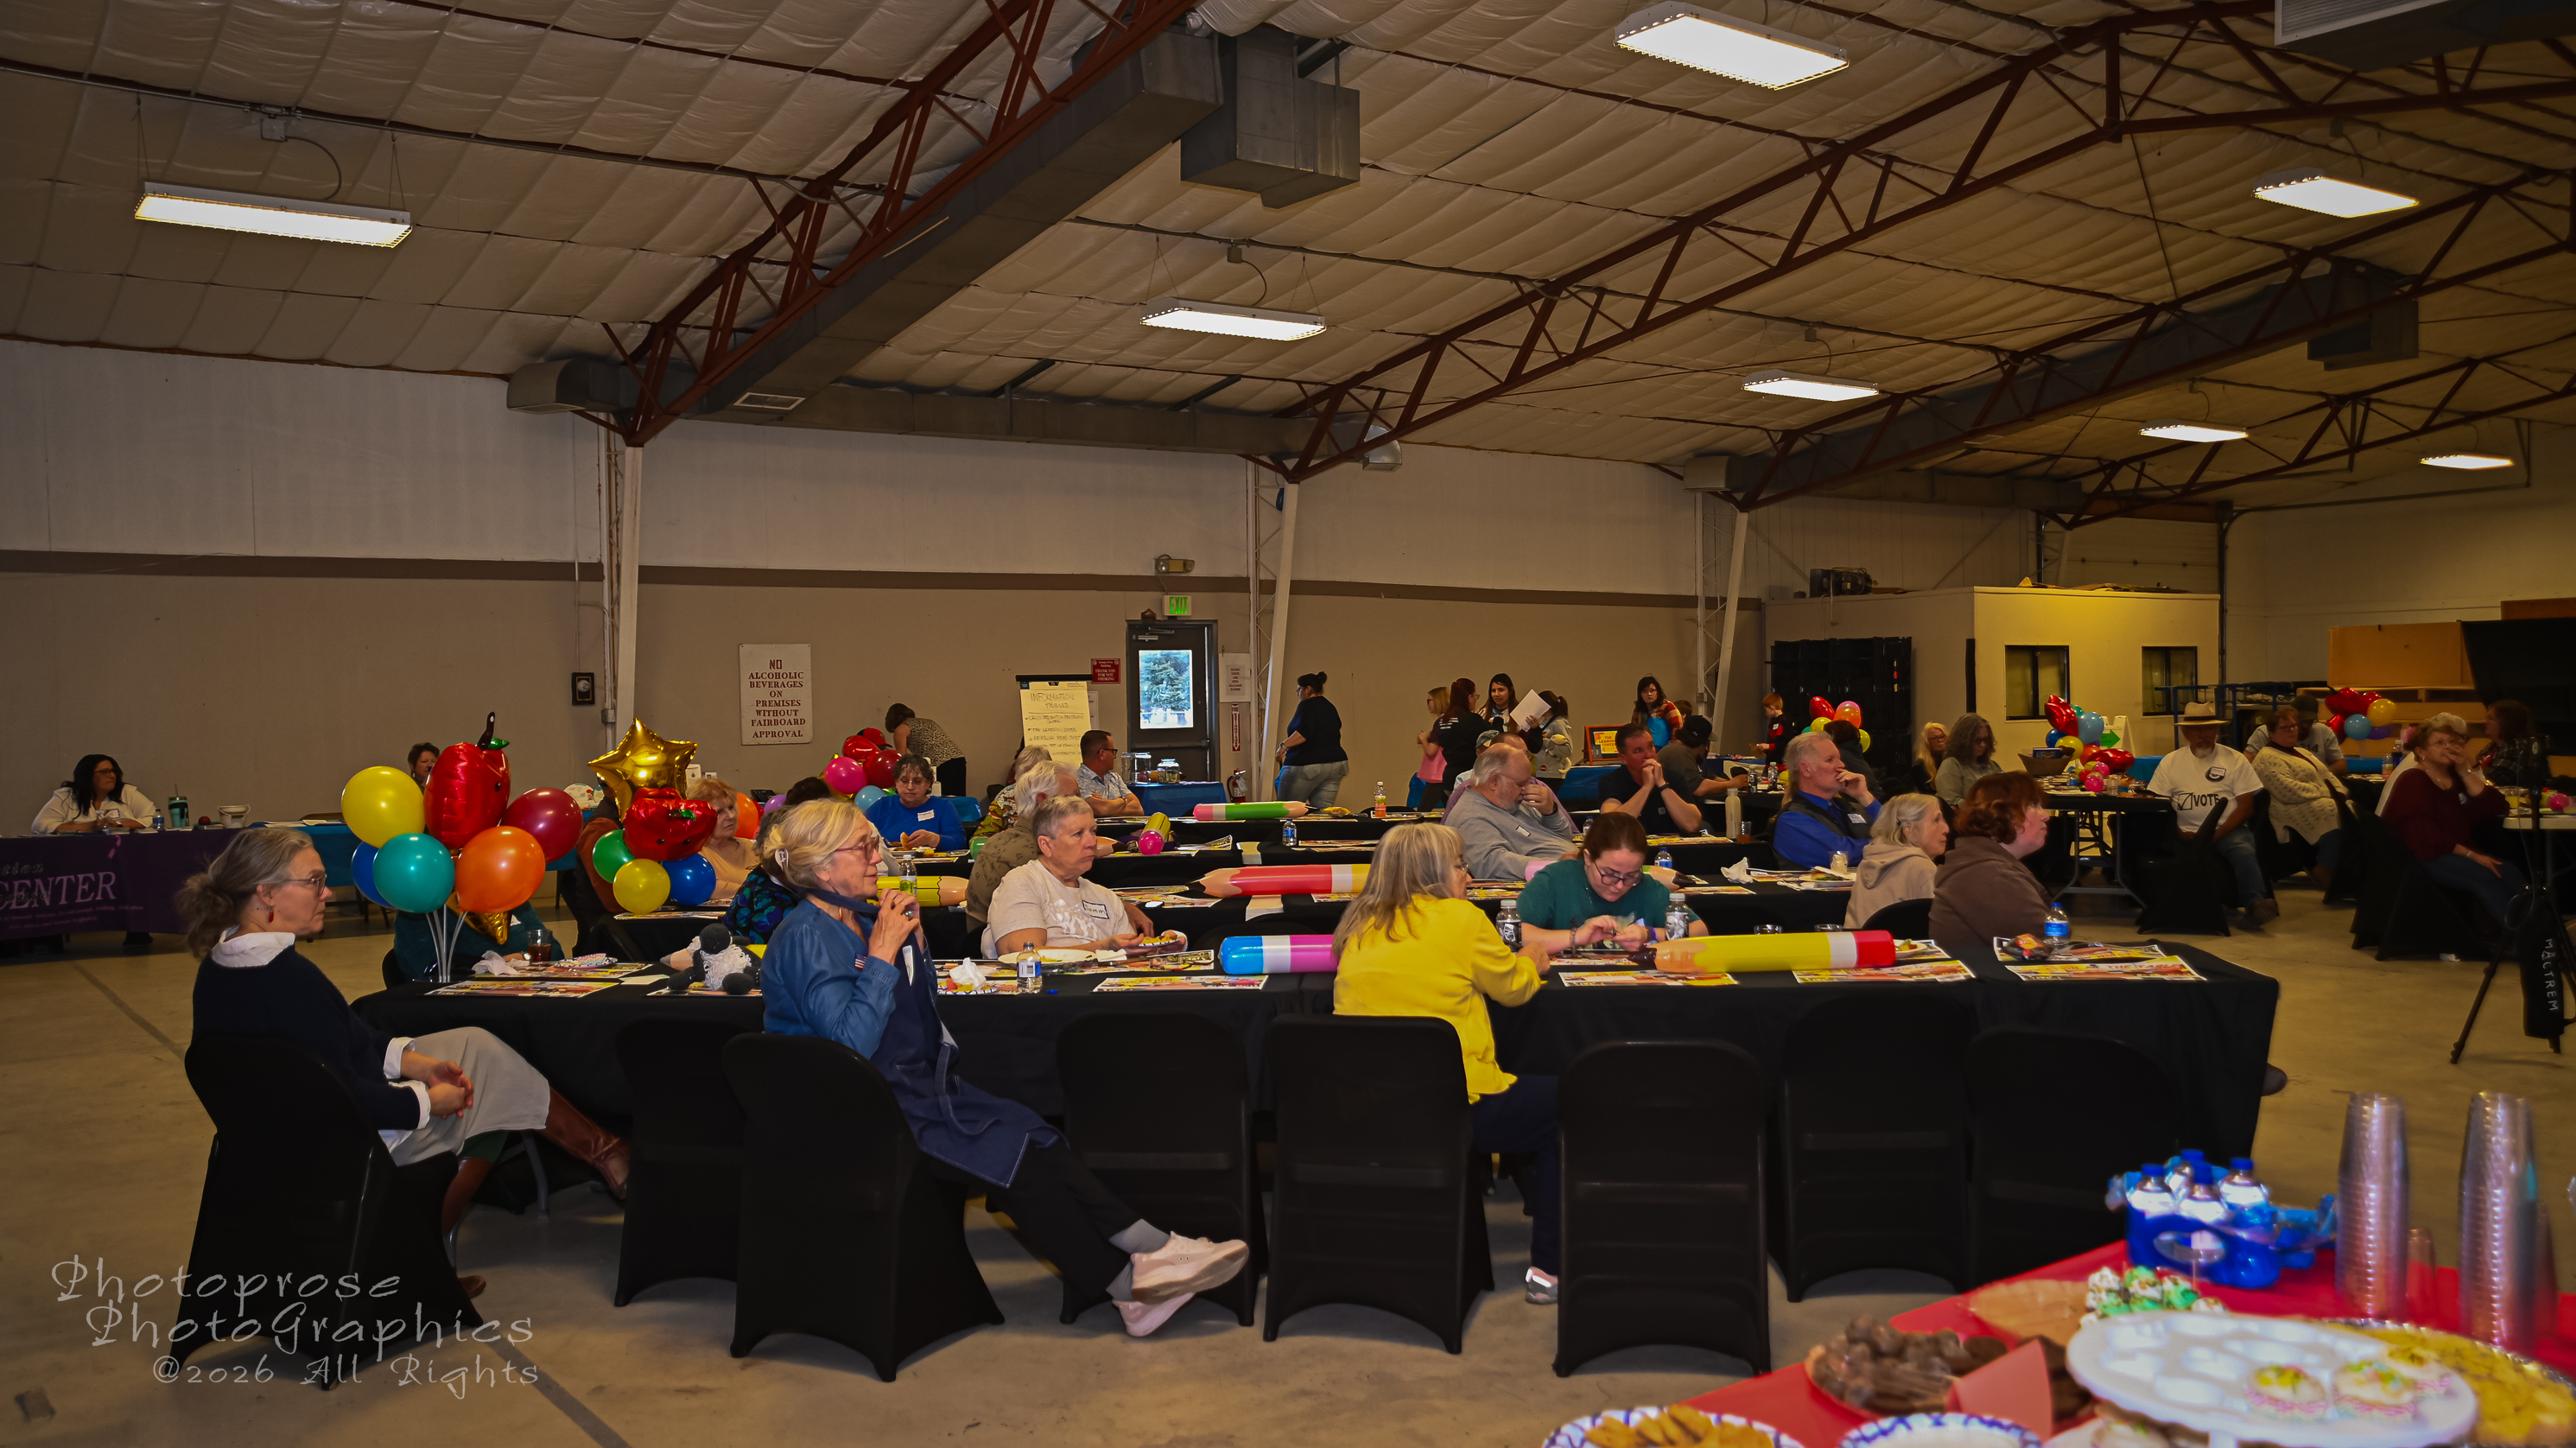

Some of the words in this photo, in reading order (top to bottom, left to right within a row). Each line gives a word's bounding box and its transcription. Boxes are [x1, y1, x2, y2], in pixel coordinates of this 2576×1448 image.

[1170, 597, 1188, 614] EXIT
[769, 659, 783, 670] NO
[1030, 693, 1075, 702] INFORMATION
[752, 730, 803, 739] APPROVAL
[2193, 794, 2220, 807] VOTE
[0, 890, 51, 903] ouse
